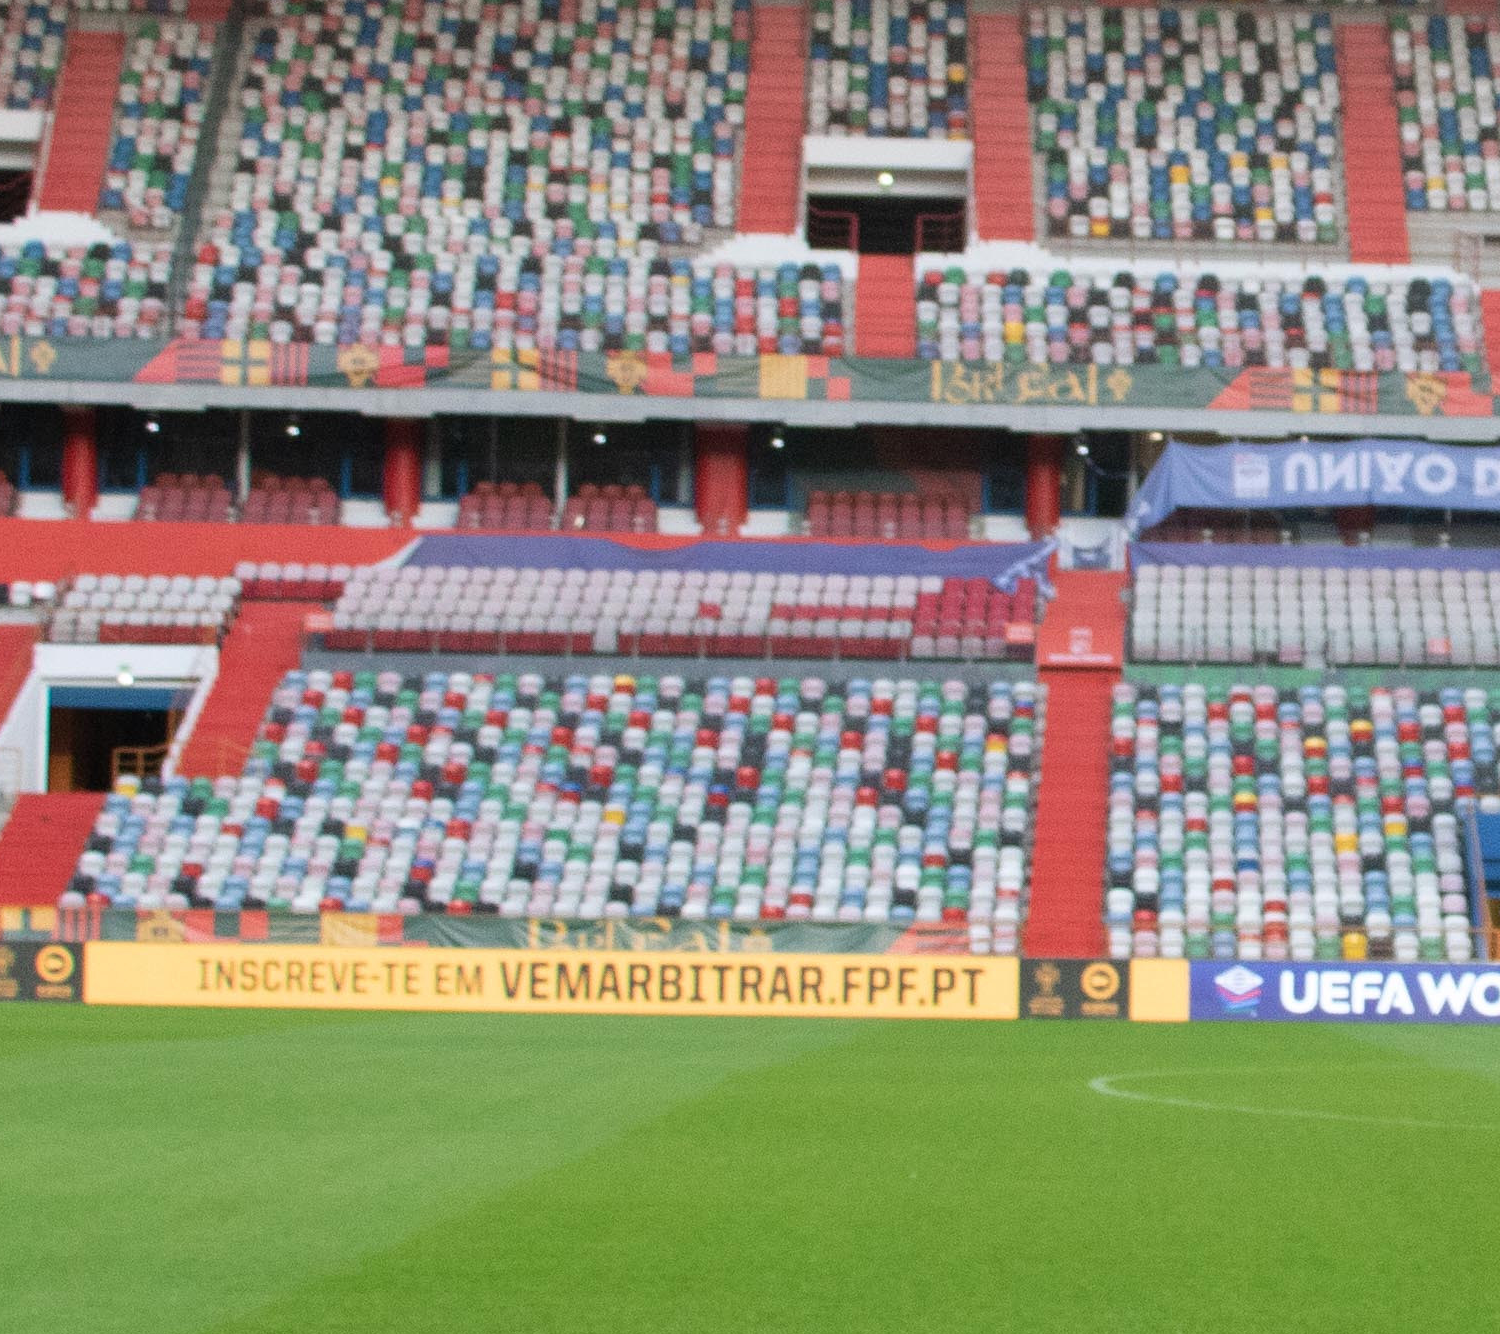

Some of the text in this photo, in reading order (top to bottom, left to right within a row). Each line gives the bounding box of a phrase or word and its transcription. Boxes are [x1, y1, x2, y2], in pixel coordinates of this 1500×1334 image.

[198, 959, 986, 1006] INSCREVE-TE EM VEMARBITRAR.FPF.PT
[1279, 969, 1415, 1016] UEFA
